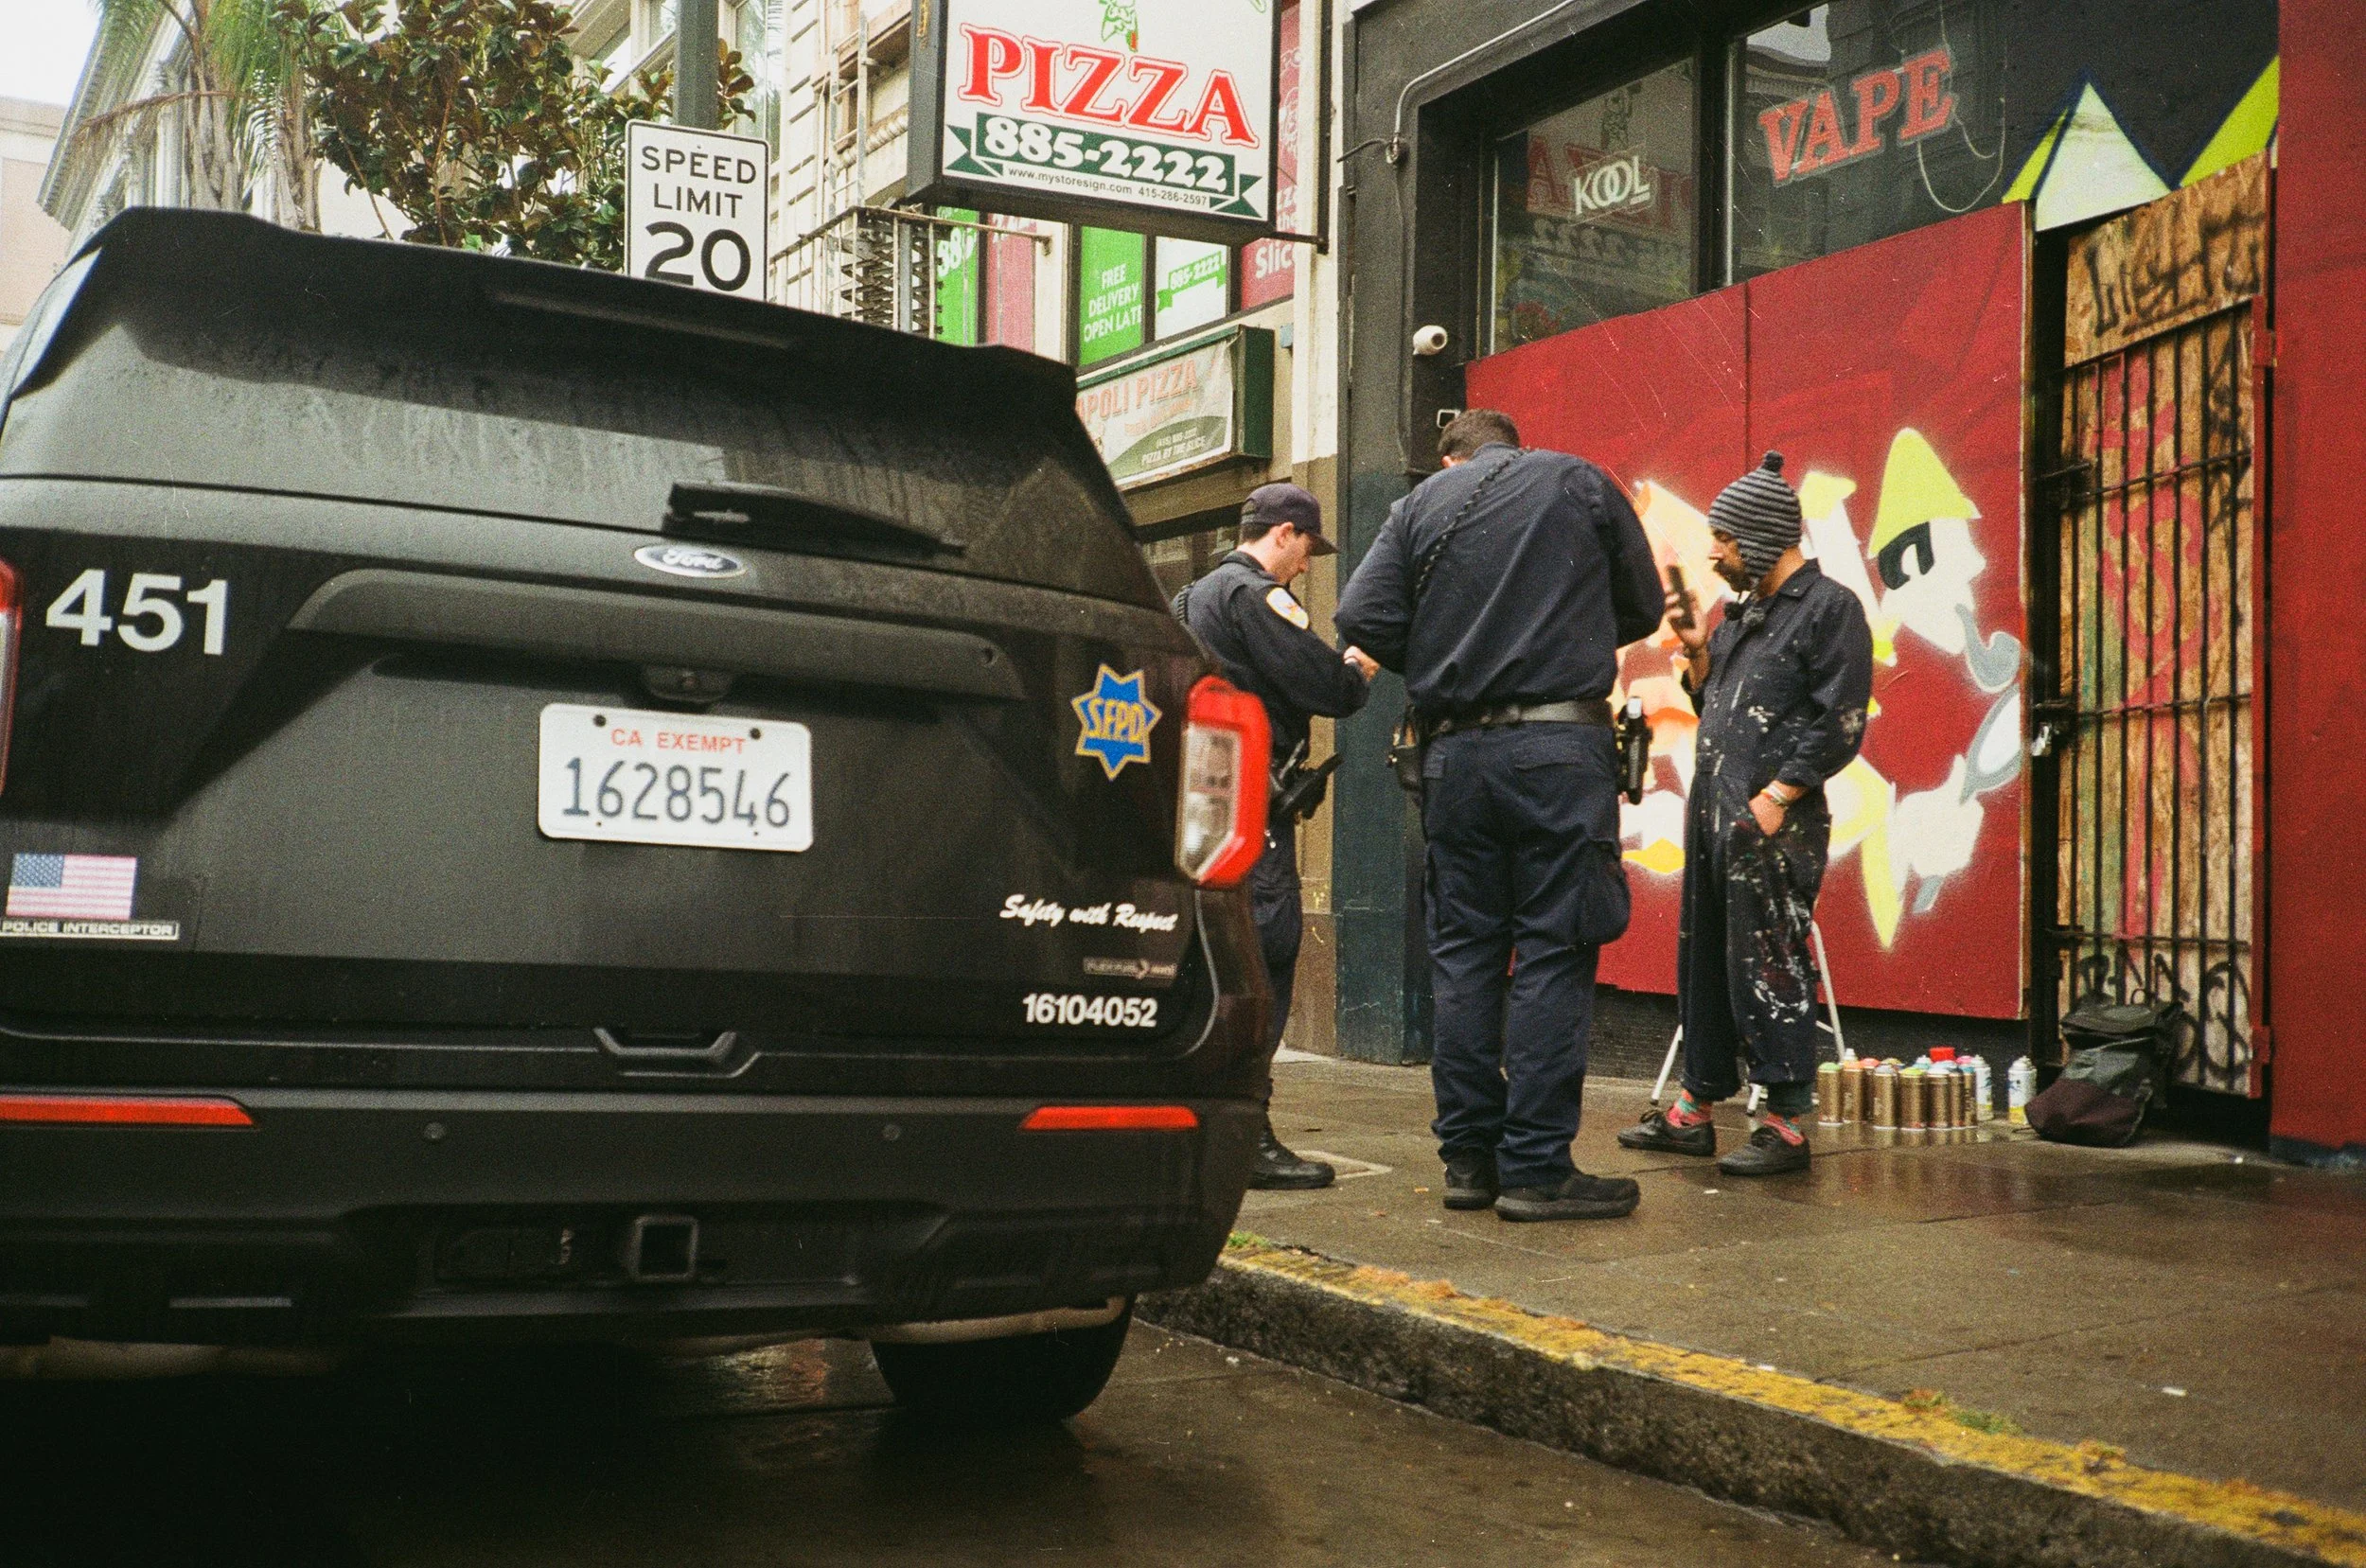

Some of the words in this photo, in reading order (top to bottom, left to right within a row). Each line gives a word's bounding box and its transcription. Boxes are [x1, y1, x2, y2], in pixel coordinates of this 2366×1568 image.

[959, 25, 1259, 148] PIZZA
[1757, 47, 1954, 183] VAPE
[641, 146, 756, 185] SPEED
[984, 116, 1227, 192] 885-2222
[654, 183, 743, 219] LIMIT
[1008, 167, 1133, 195] www.mystoresign.com
[1139, 188, 1208, 206] 415-286-2597
[1574, 155, 1651, 216] KOOL
[644, 220, 751, 291] 20
[1170, 255, 1221, 290] 885-2222
[1102, 263, 1127, 290] FREE
[1089, 282, 1139, 318] DELIVERY
[1084, 317, 1114, 343] OPEN
[1135, 359, 1199, 409] PIZZA
[662, 547, 723, 569] Ford
[45, 568, 228, 655] 451
[1086, 697, 1145, 743] SFPD
[610, 728, 644, 747] CA
[656, 731, 747, 754] EXEMPT
[562, 757, 790, 828] 1628546
[2, 920, 59, 933] POLICE
[62, 922, 173, 936] INTERCEPTOR
[999, 894, 1066, 927] Safety
[1069, 902, 1112, 925] with
[1023, 993, 1158, 1028] 16104052
